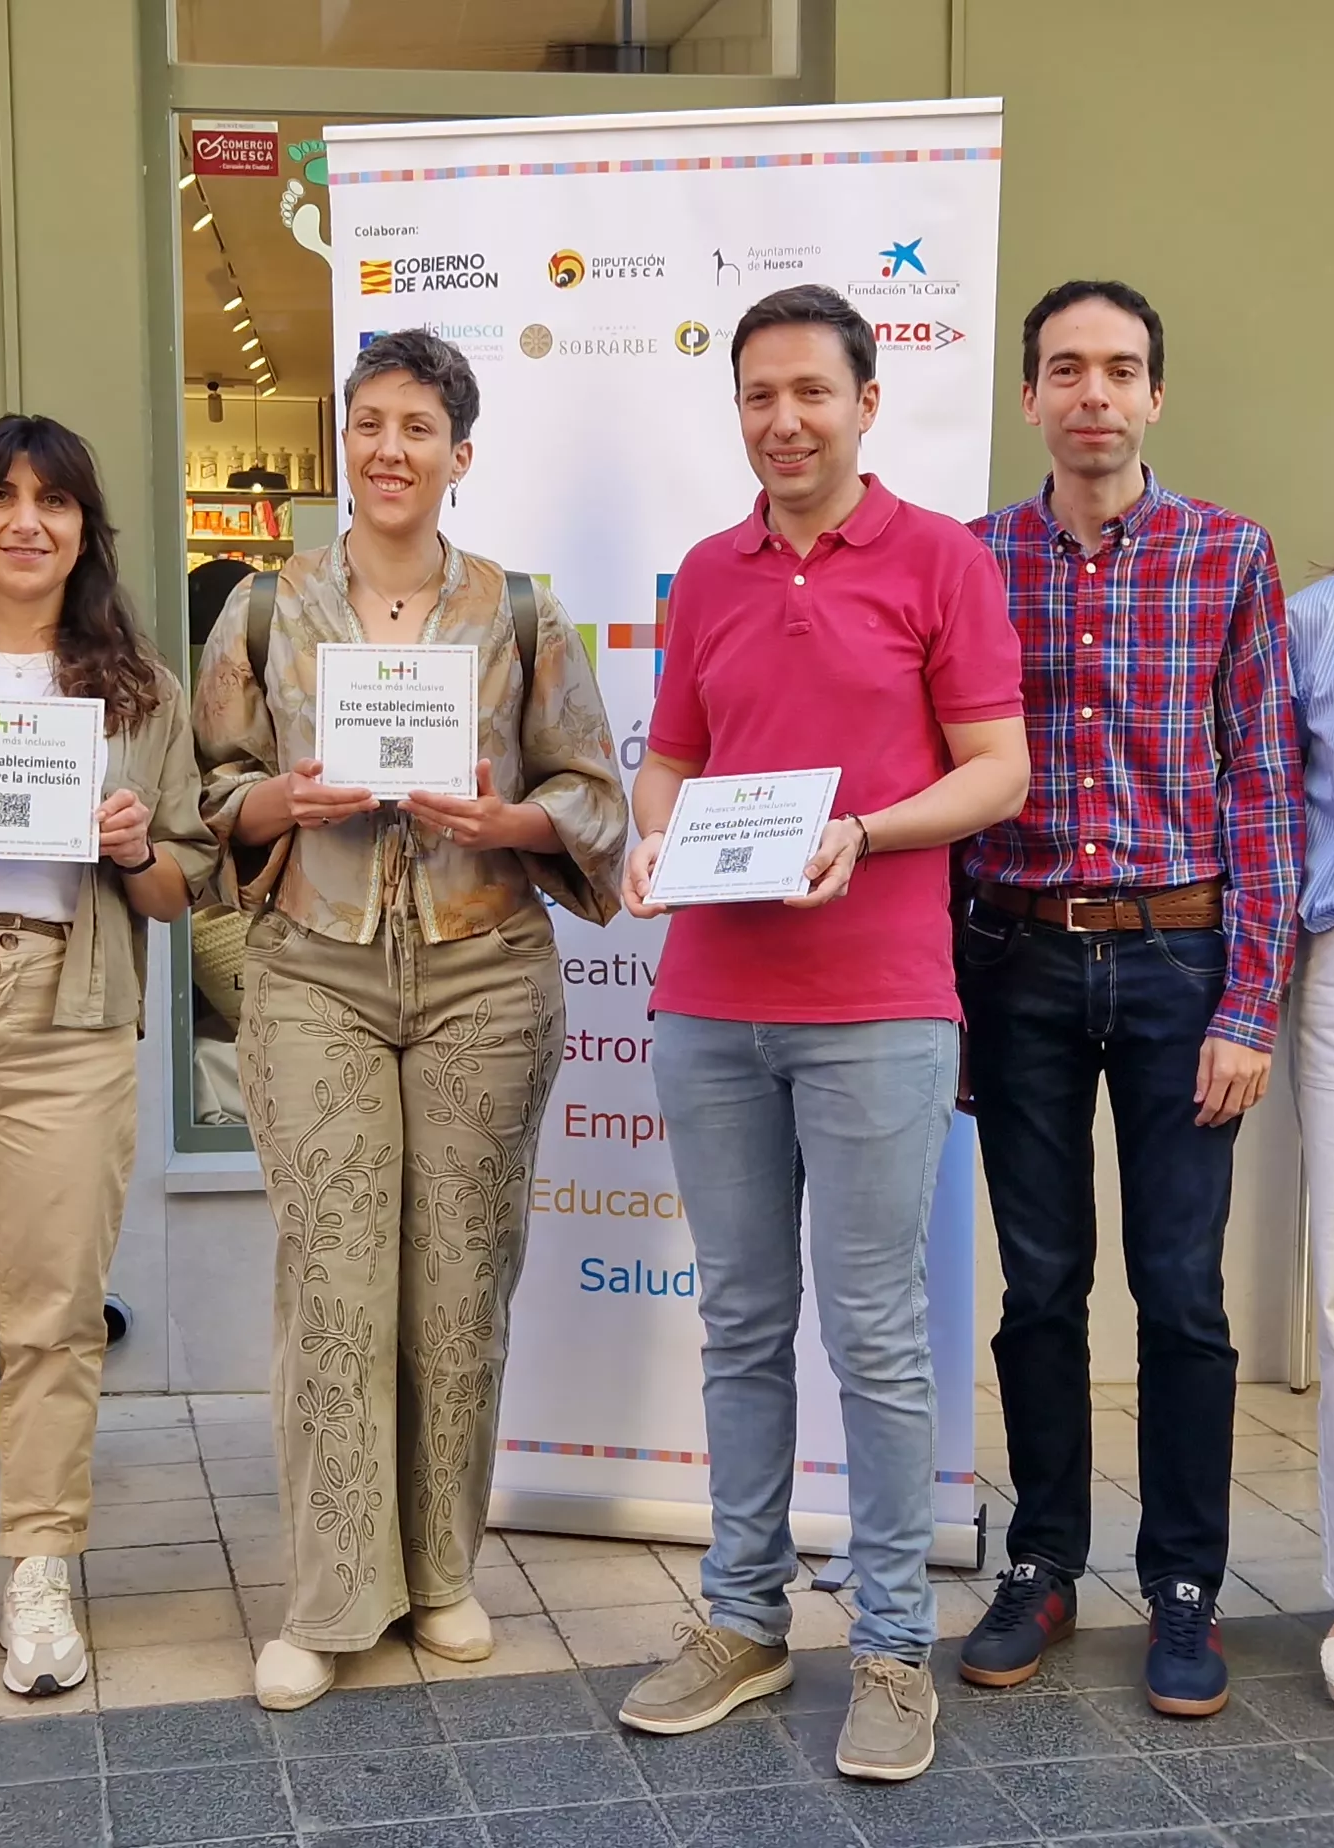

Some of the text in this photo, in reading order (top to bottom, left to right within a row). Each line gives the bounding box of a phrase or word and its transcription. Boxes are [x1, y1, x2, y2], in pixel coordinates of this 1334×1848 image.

[222, 139, 273, 150] COMERCIO
[222, 150, 273, 161] HUESCA
[354, 225, 419, 237] Colaboran:
[747, 245, 822, 259] Ayuntamiento
[394, 253, 485, 275] GOBIERNO
[592, 254, 665, 268] DIPUTACIÓN
[747, 259, 804, 271] de Huesca
[592, 268, 665, 279] HUESCA
[394, 272, 499, 293] DE ARAGON
[847, 284, 906, 296] Fundación
[422, 321, 504, 338] ishuesca
[872, 323, 931, 342] nza
[559, 339, 658, 356] SOBRARBE
[351, 682, 382, 691] Huesca
[339, 700, 455, 712] Este establecimiento
[335, 716, 459, 729] promueve la inclusión
[12, 771, 23, 783] la
[27, 772, 81, 785] inclusión
[689, 815, 803, 831] Este establecimiento
[680, 827, 804, 846] promueve la inclusión
[560, 953, 657, 986] eativ
[565, 1103, 664, 1148] Empl
[531, 1179, 683, 1218] Educaci
[580, 1257, 695, 1297] Salud
